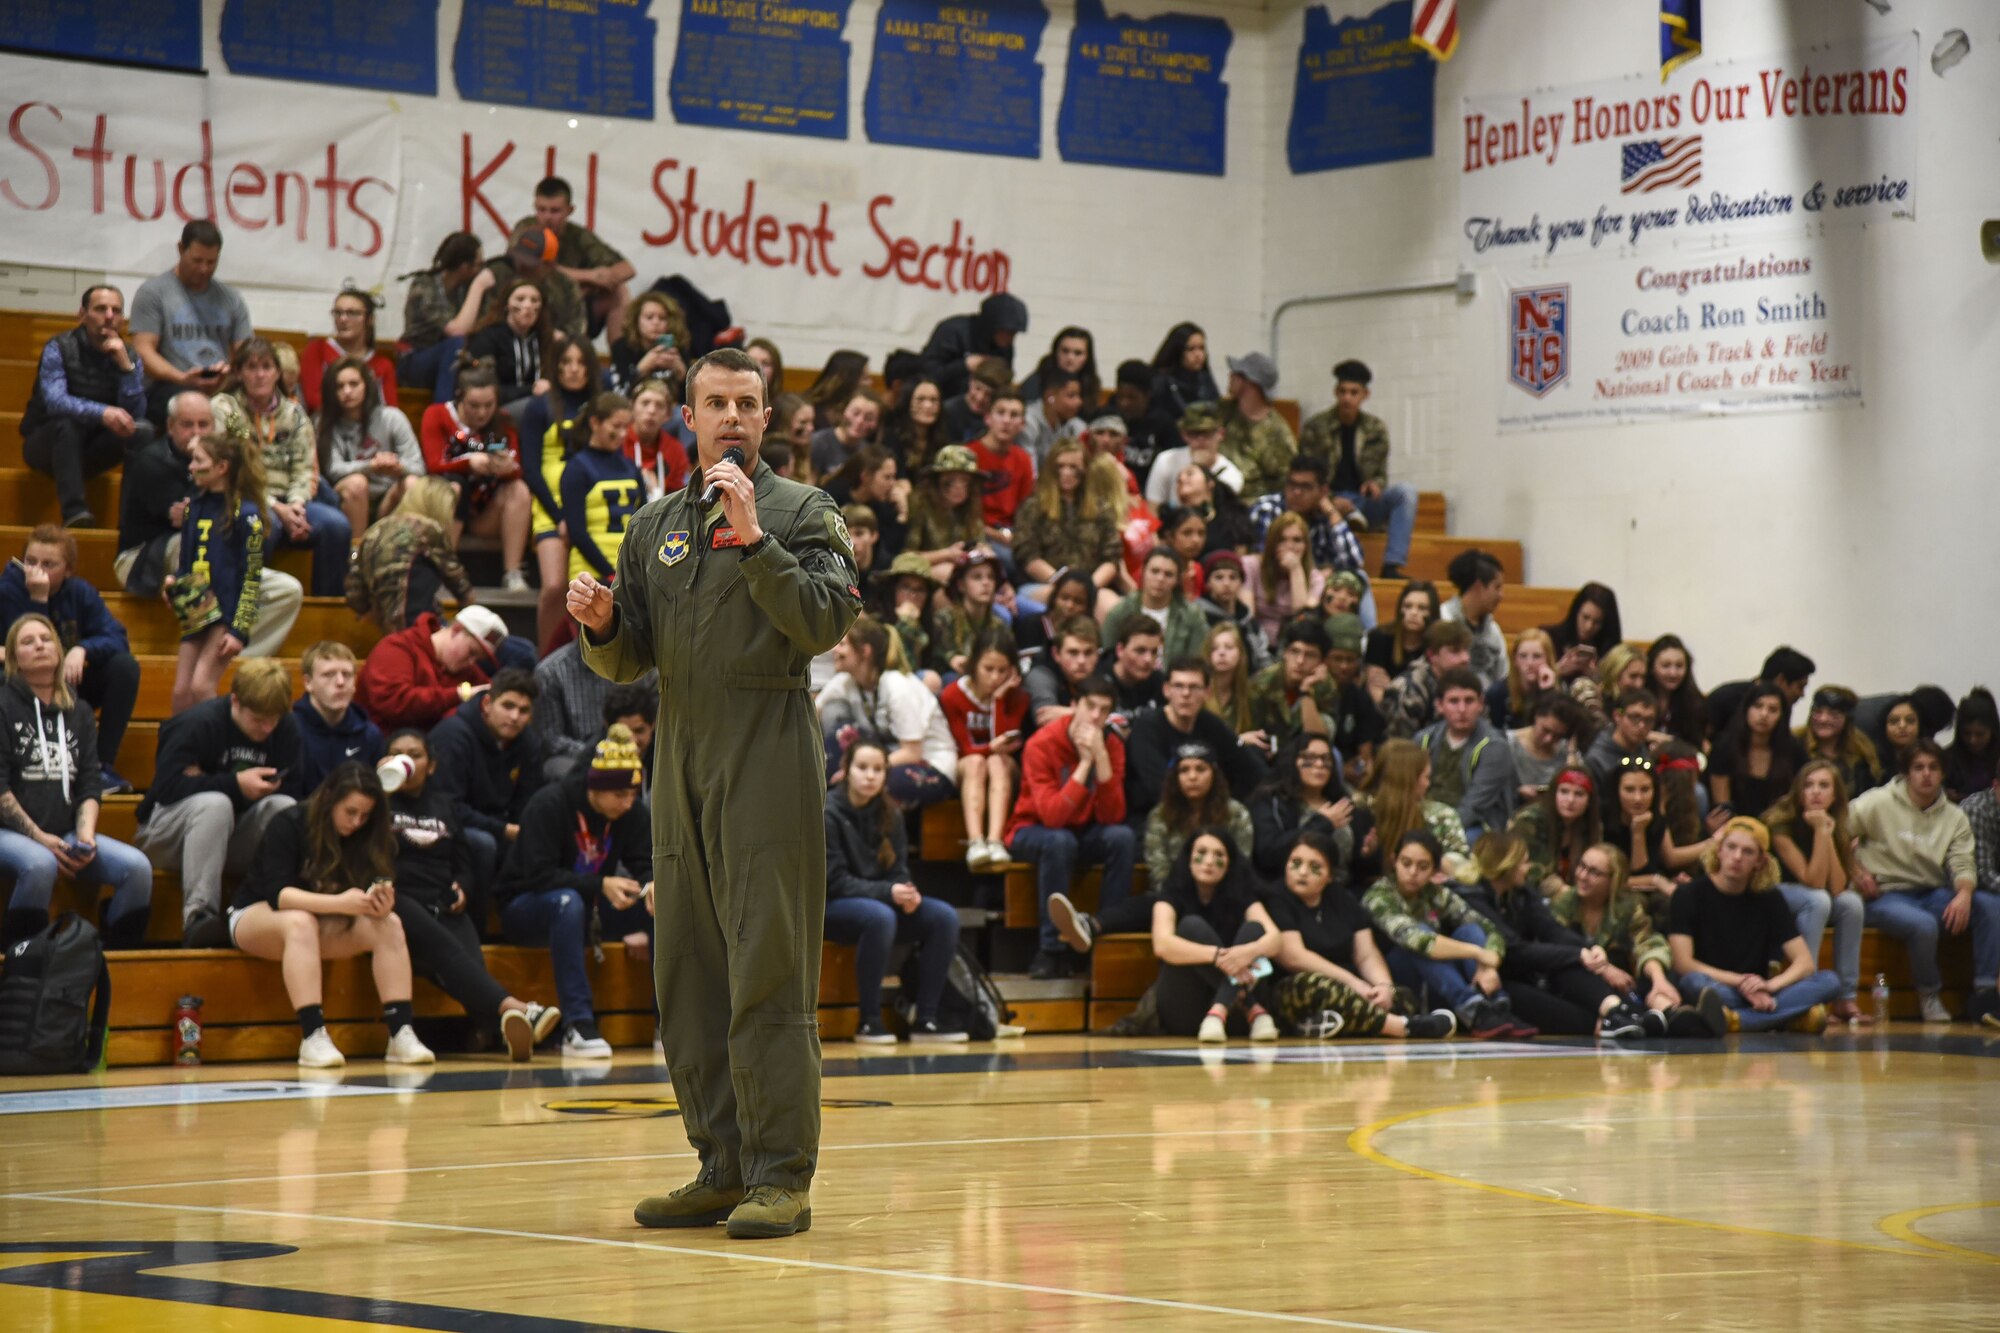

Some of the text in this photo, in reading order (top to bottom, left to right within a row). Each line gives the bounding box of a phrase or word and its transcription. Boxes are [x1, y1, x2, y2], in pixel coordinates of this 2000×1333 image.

[1463, 98, 1565, 173] Henley
[1571, 93, 1680, 145] Honors
[1690, 78, 1751, 124] Our
[1758, 66, 1908, 119] Veterans
[0, 101, 397, 258] Students
[642, 159, 841, 277] Student
[863, 196, 1012, 296] Section
[1464, 174, 1908, 255] Thank you for your dedication & service
[1636, 253, 1812, 296] Congratulations
[1621, 291, 1827, 337] Coach Ron Smith
[1593, 359, 1851, 400] National Coach of the Year
[1614, 332, 1829, 373] 2009 Girls Track & Field
